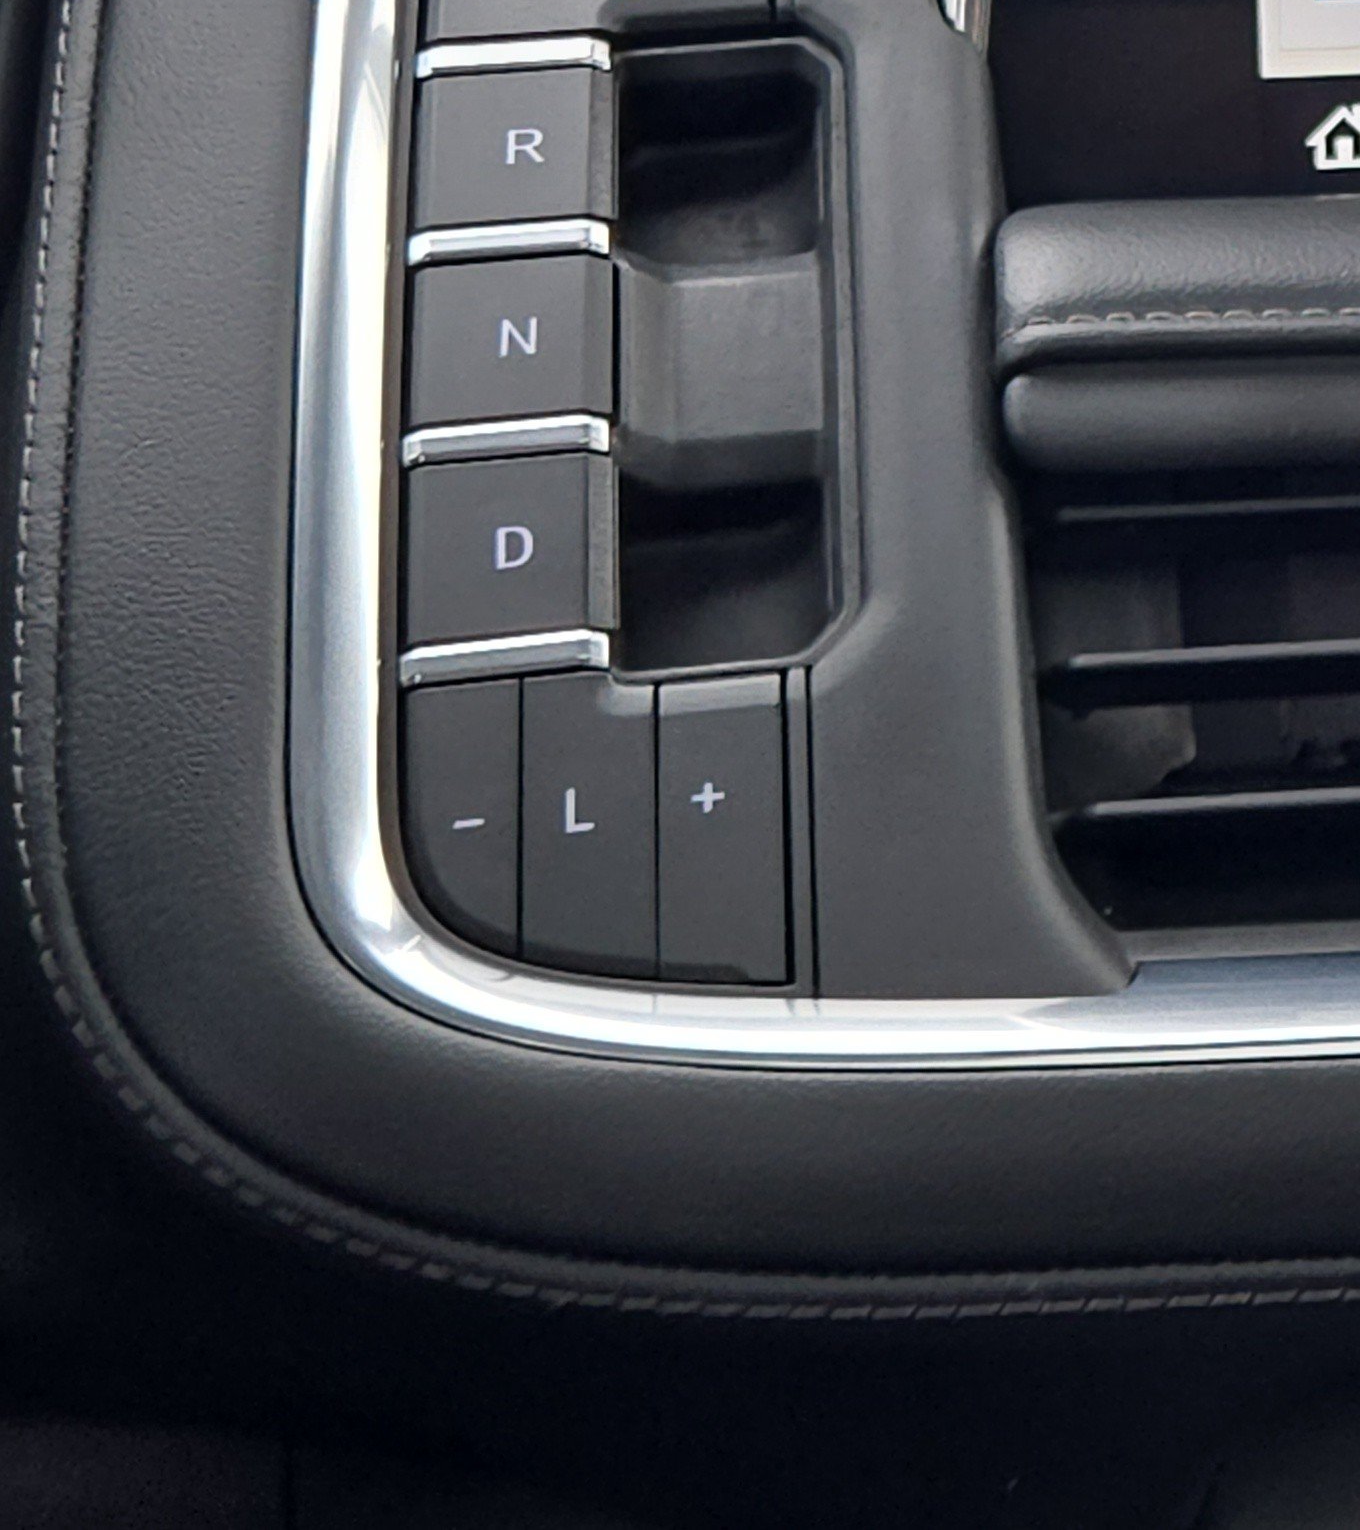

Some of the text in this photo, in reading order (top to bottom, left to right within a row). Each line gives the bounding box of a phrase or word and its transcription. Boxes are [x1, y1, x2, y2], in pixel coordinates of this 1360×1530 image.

[506, 128, 544, 165] R
[498, 316, 538, 357] N
[495, 526, 535, 567] D
[565, 787, 595, 833] L
